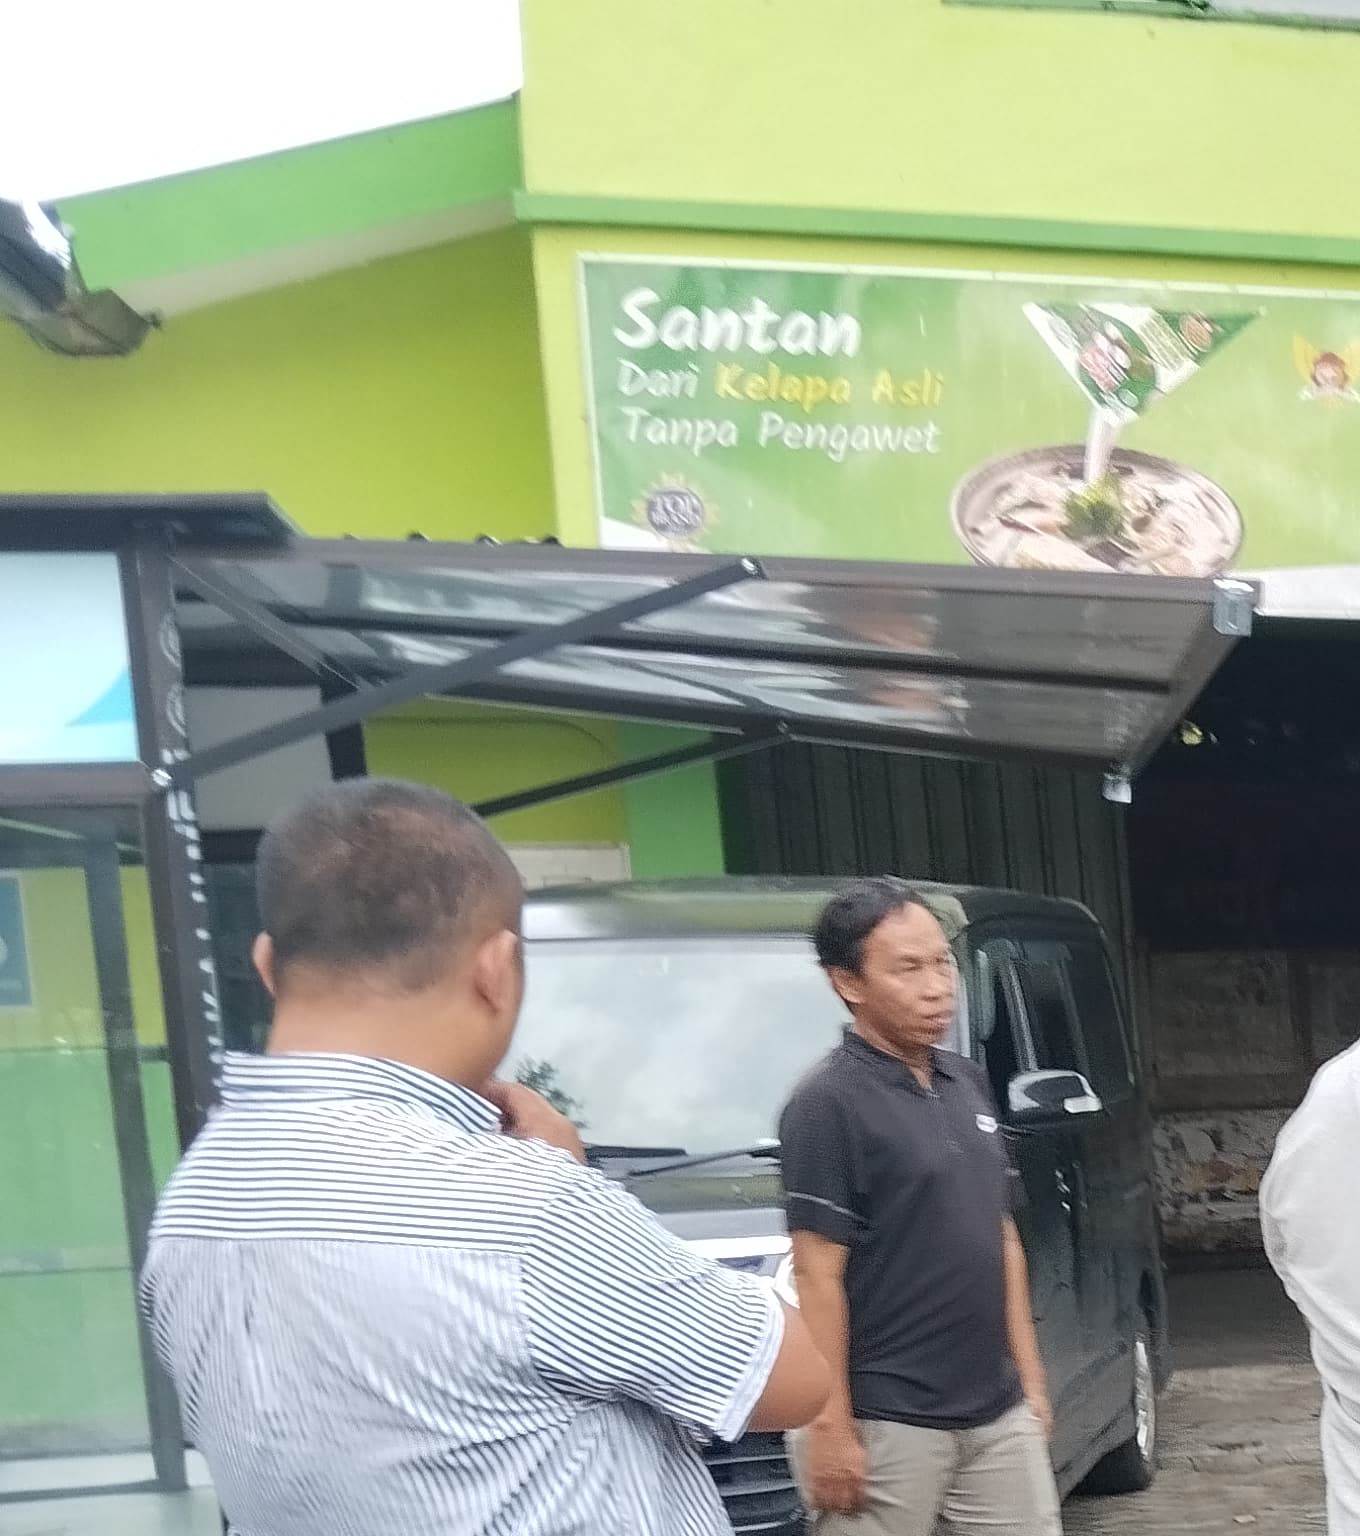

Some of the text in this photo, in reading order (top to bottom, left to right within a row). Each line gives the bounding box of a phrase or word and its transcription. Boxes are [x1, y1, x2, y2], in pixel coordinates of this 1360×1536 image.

[613, 287, 861, 358] Santan
[617, 357, 944, 413] Dari Kelapa Asli
[619, 405, 942, 463] Tanpa Pengawet
